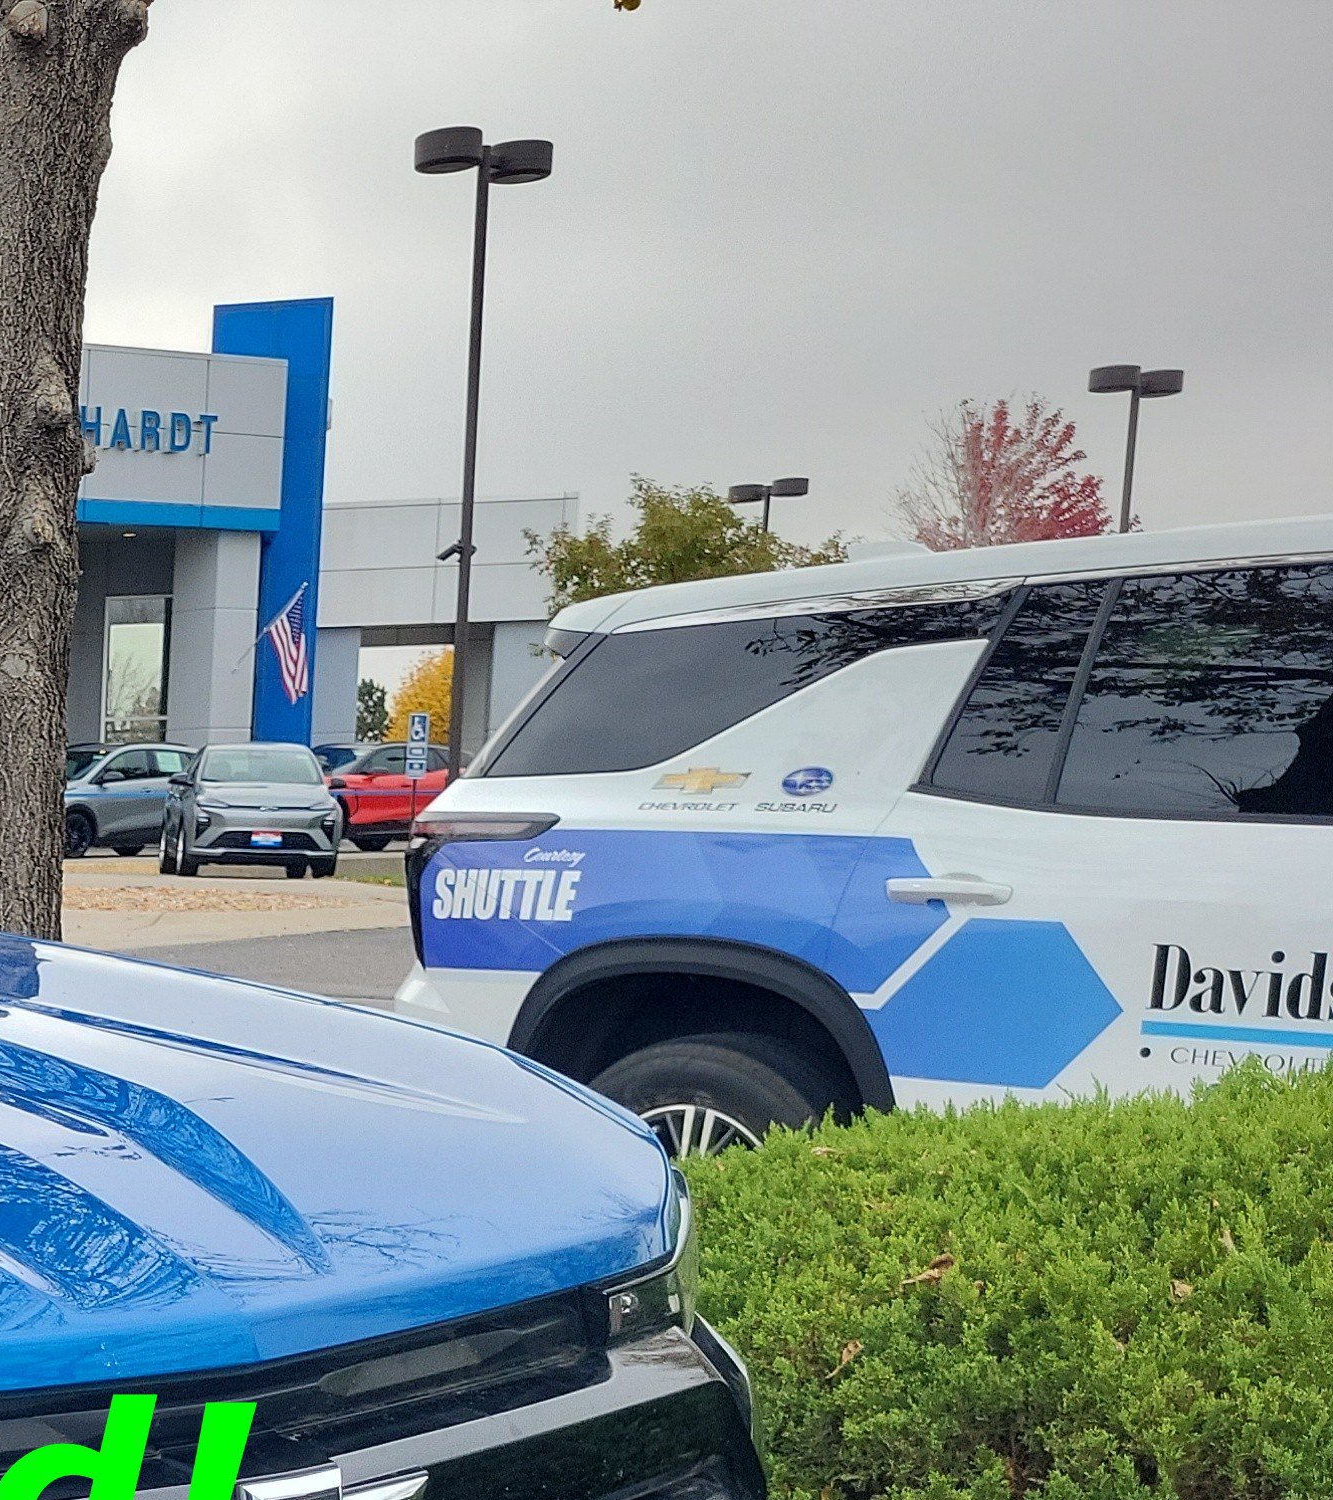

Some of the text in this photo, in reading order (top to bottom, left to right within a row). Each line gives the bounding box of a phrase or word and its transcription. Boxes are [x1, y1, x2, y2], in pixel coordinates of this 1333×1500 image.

[637, 802, 738, 813] CHEVROLET
[753, 802, 838, 814] SUBARU
[523, 847, 585, 867] Courtesy
[432, 869, 582, 922] SHUTTLE
[1145, 942, 1333, 1022] David
